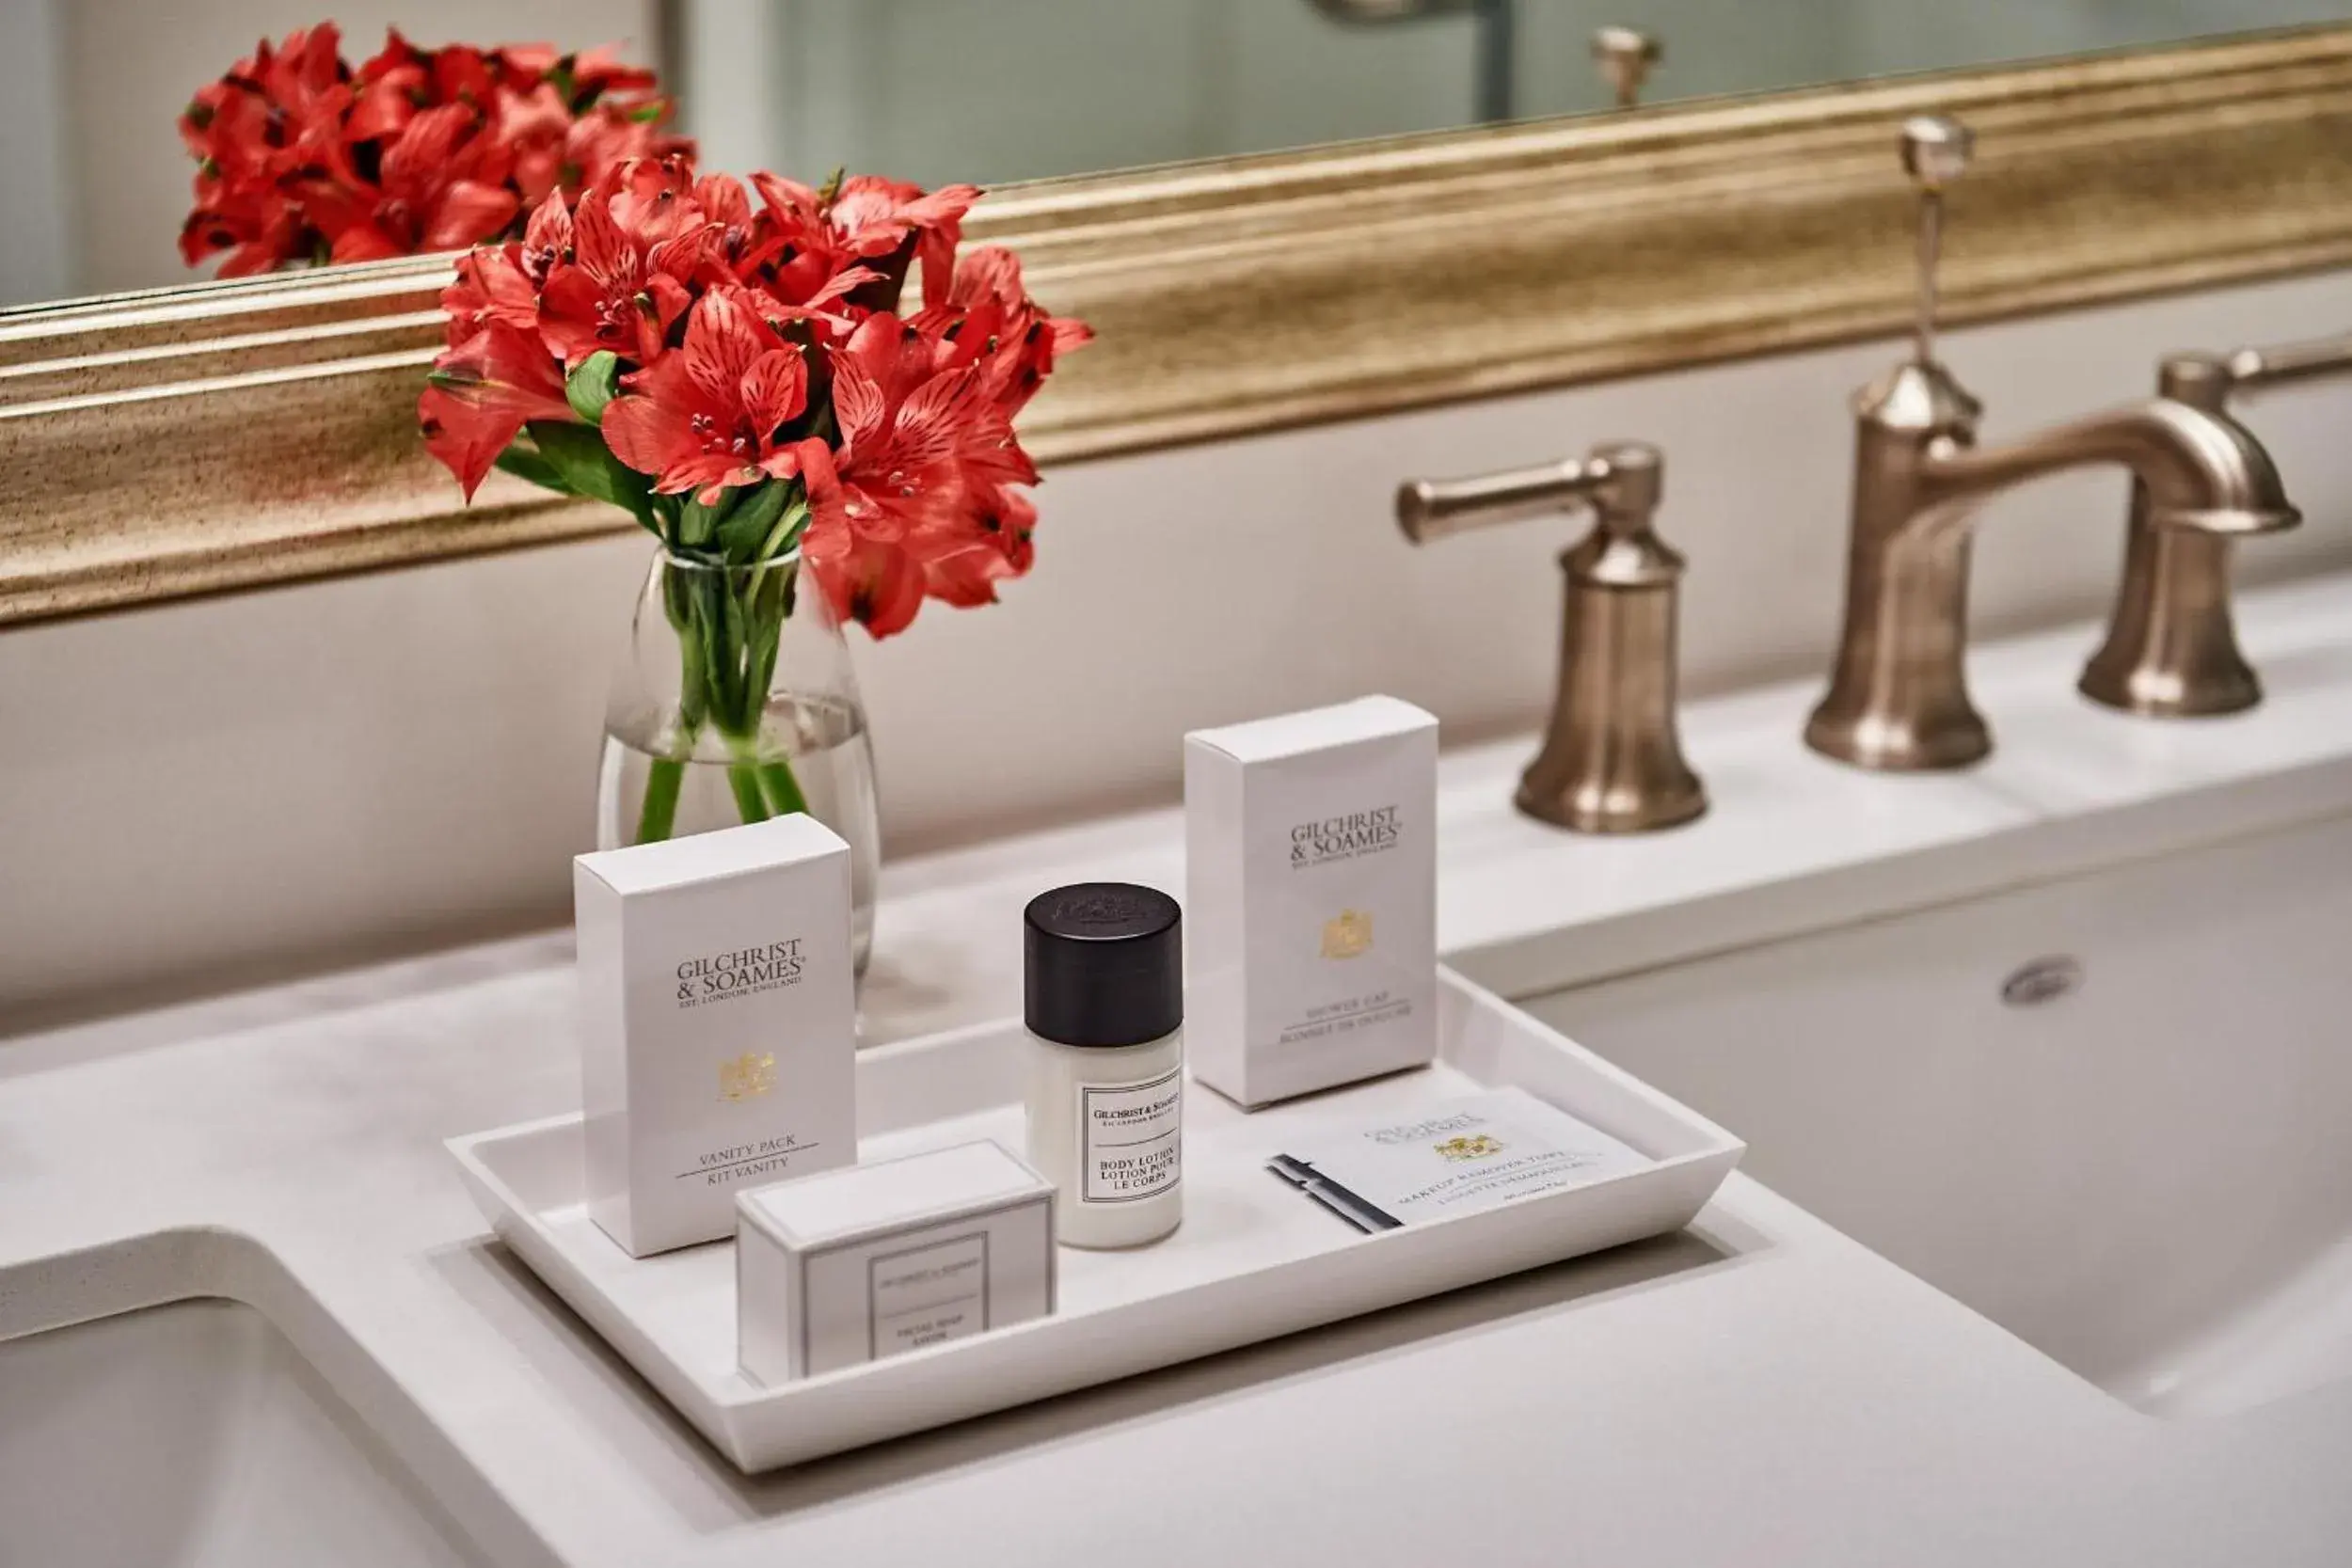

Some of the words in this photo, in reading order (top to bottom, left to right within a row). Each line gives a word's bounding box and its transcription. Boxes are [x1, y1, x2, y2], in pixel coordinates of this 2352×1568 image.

[1292, 804, 1399, 843] GILCHRIST
[1291, 845, 1306, 861] &
[1313, 824, 1397, 856] SOAMES
[677, 939, 801, 979] GILCHRIST
[677, 983, 693, 999] &
[1094, 1108, 1143, 1119] GILCHRIST
[700, 1144, 754, 1165] VANITY
[759, 1133, 796, 1151] PACK
[1100, 1159, 1135, 1170] BODY
[1139, 1145, 1173, 1166] LOTION
[707, 1170, 730, 1186] KIT
[735, 1156, 788, 1178] VANITY
[1102, 1166, 1147, 1180] LOTION
[1150, 1156, 1173, 1173] POUR
[1115, 1180, 1128, 1189] LE
[1134, 1171, 1166, 1187] CORPS
